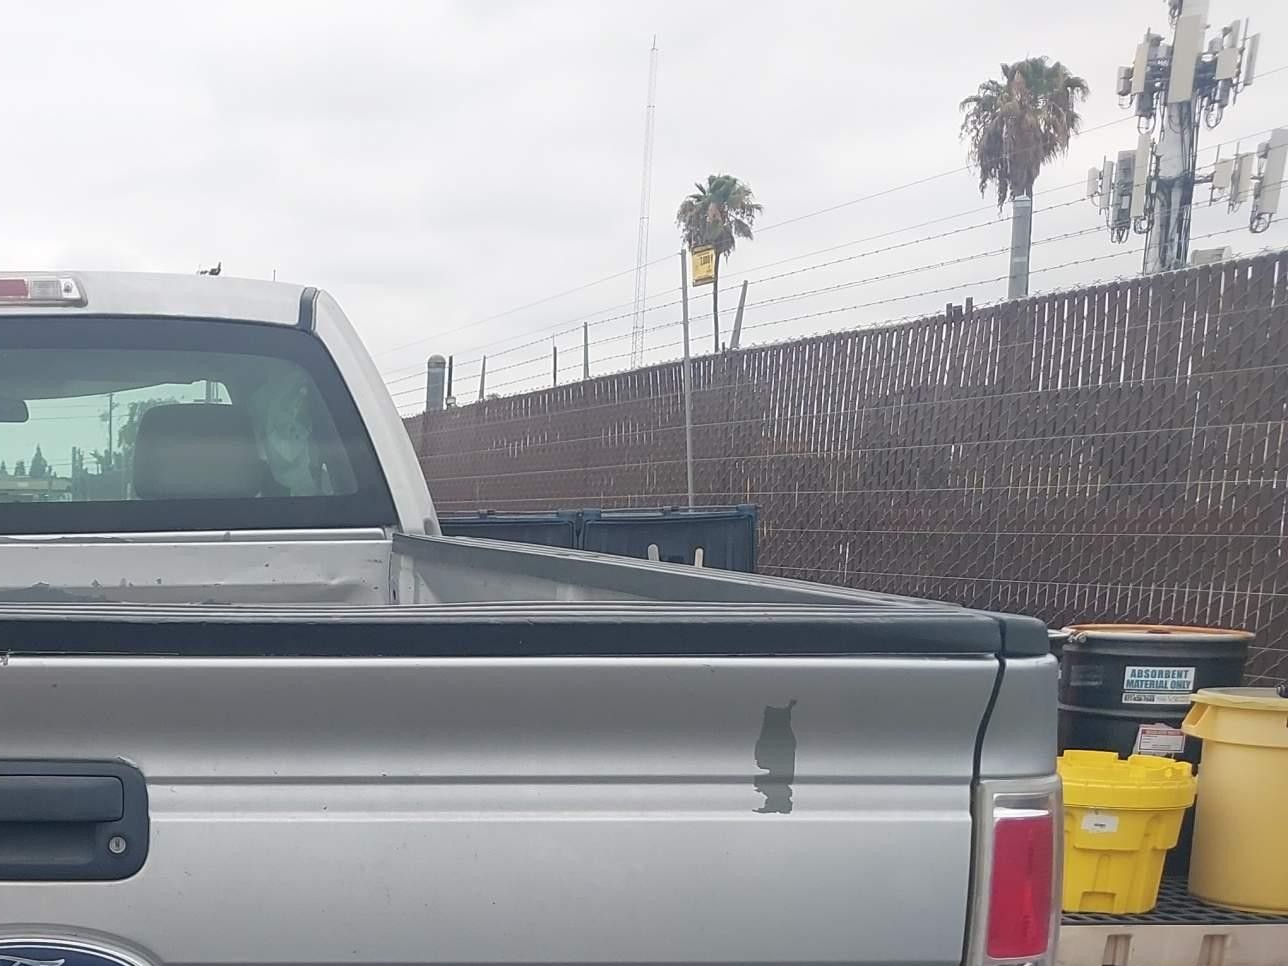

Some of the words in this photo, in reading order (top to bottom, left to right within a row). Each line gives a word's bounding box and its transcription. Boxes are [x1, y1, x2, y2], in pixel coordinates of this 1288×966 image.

[1130, 668, 1189, 679] ABSORBENT
[1125, 679, 1168, 689] MATERIAL
[1170, 679, 1191, 689] ONLY
